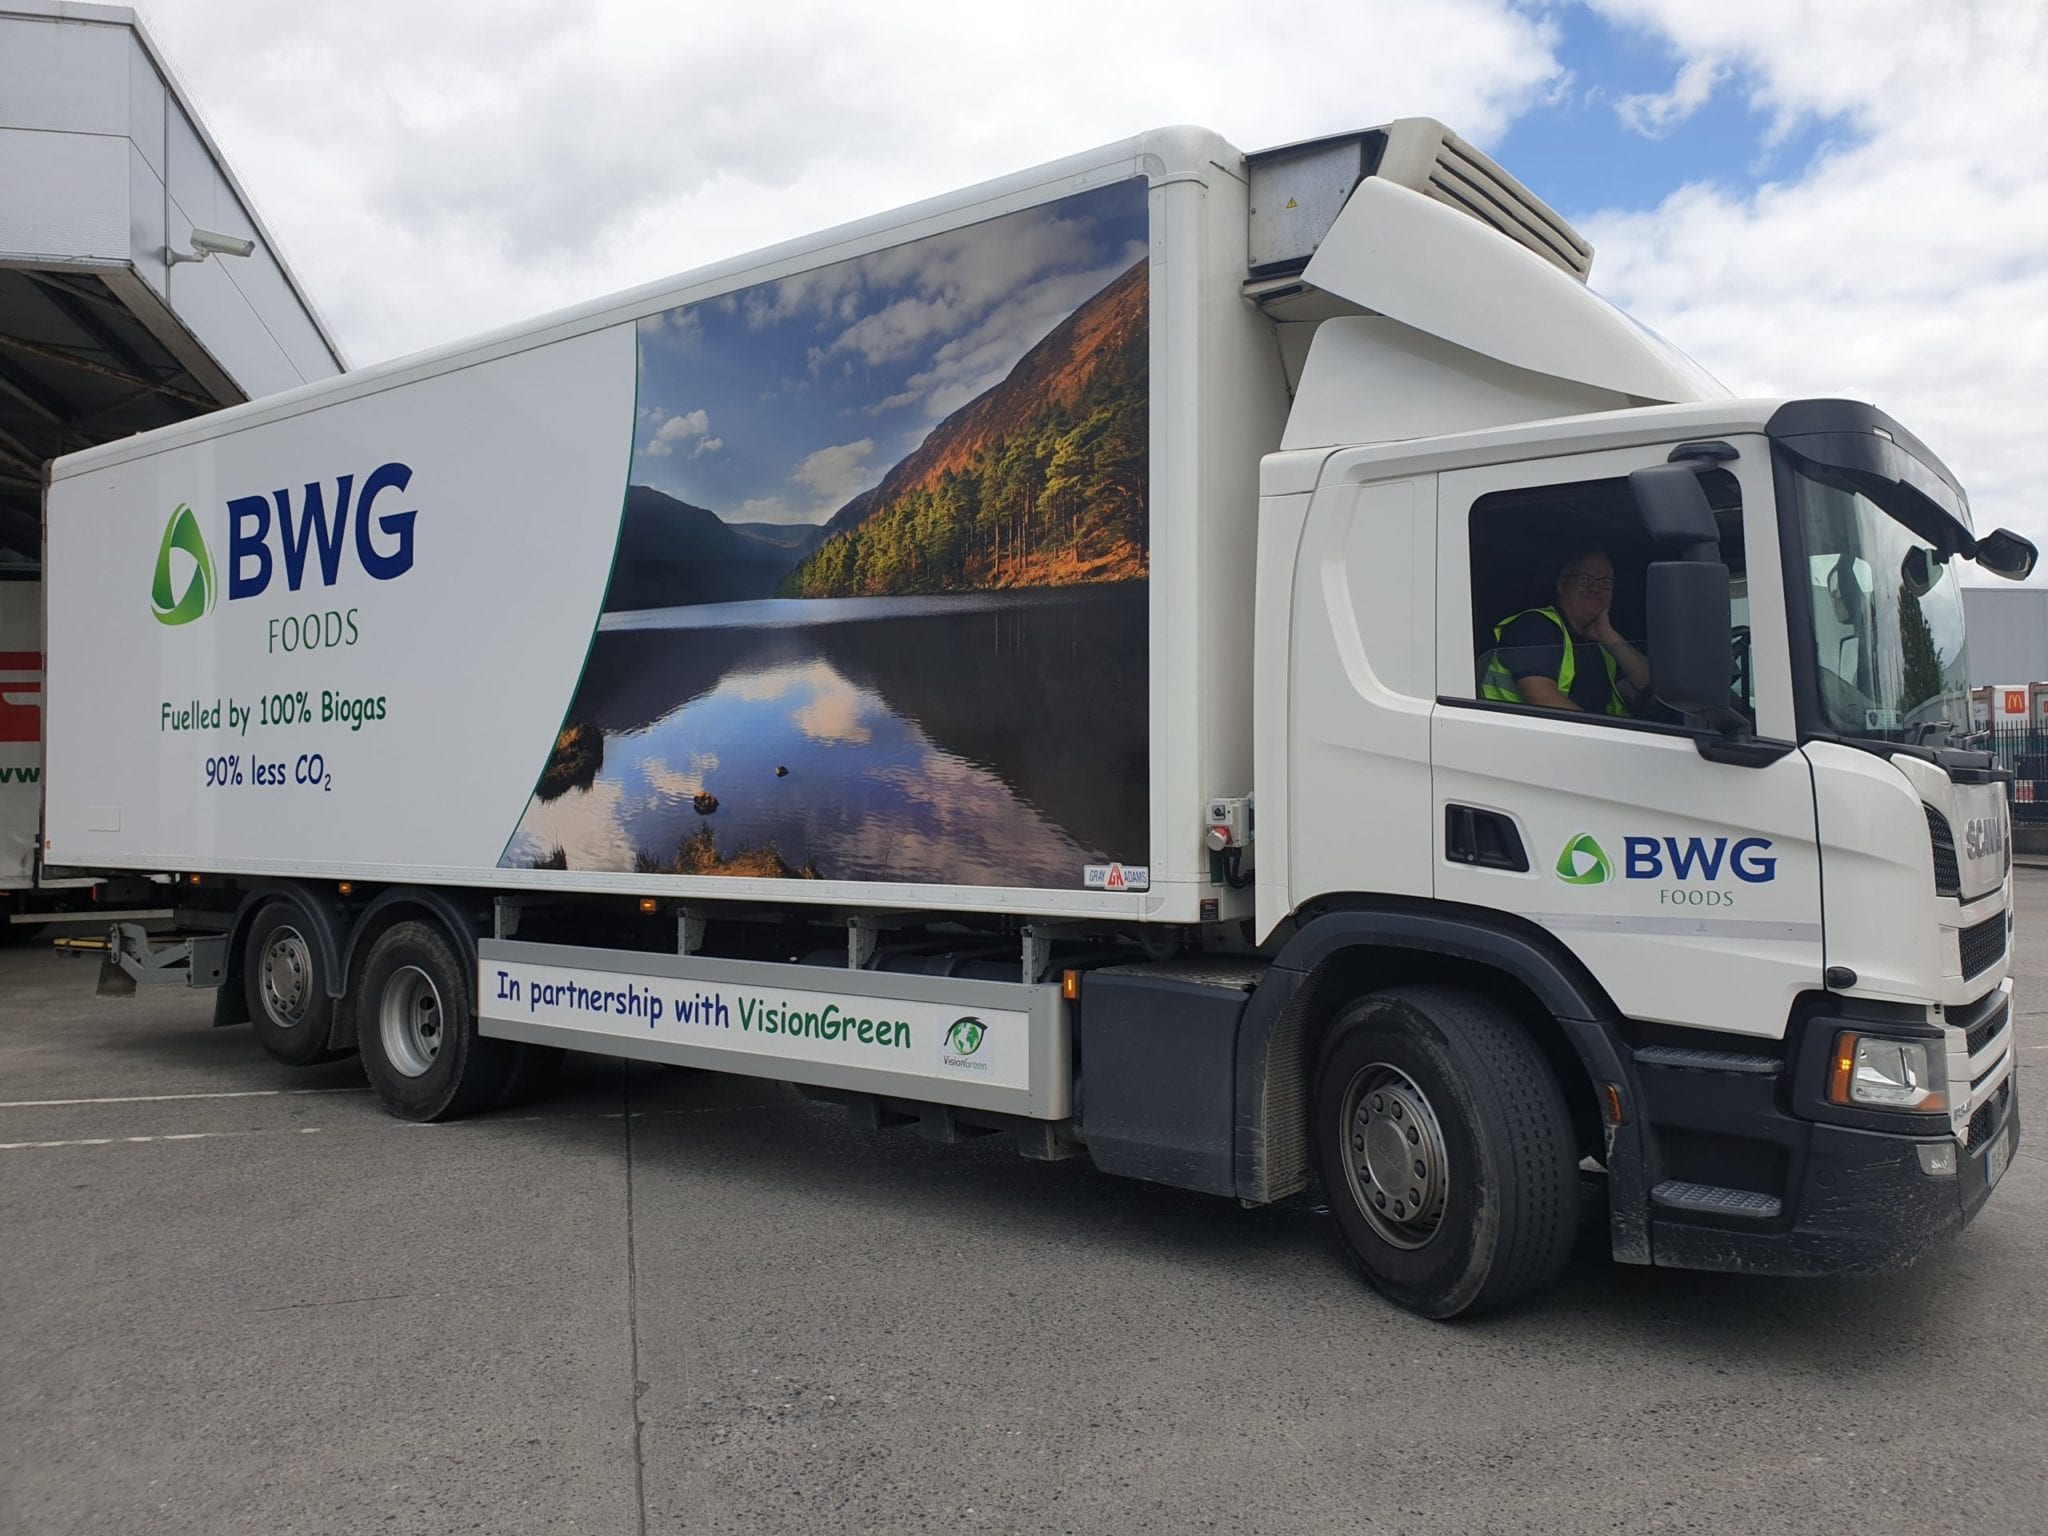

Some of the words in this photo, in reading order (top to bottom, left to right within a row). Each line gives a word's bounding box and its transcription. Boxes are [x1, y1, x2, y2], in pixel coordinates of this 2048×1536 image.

[226, 462, 418, 601] BWG
[268, 608, 360, 654] FOODS
[161, 699, 221, 732] Fuelled
[229, 699, 251, 737] by
[260, 691, 312, 726] 100%
[321, 690, 387, 732] Biogas
[205, 754, 243, 787] 90%
[251, 754, 286, 786] less
[1124, 871, 1147, 884] ADAMS
[1622, 836, 1778, 883] BWG
[1660, 889, 1734, 907] FOODS
[497, 970, 521, 1002] In
[530, 980, 664, 1029] partnership
[675, 992, 730, 1029] with
[738, 997, 911, 1049] VisionGreen
[943, 1055, 988, 1070] VisionGreen
